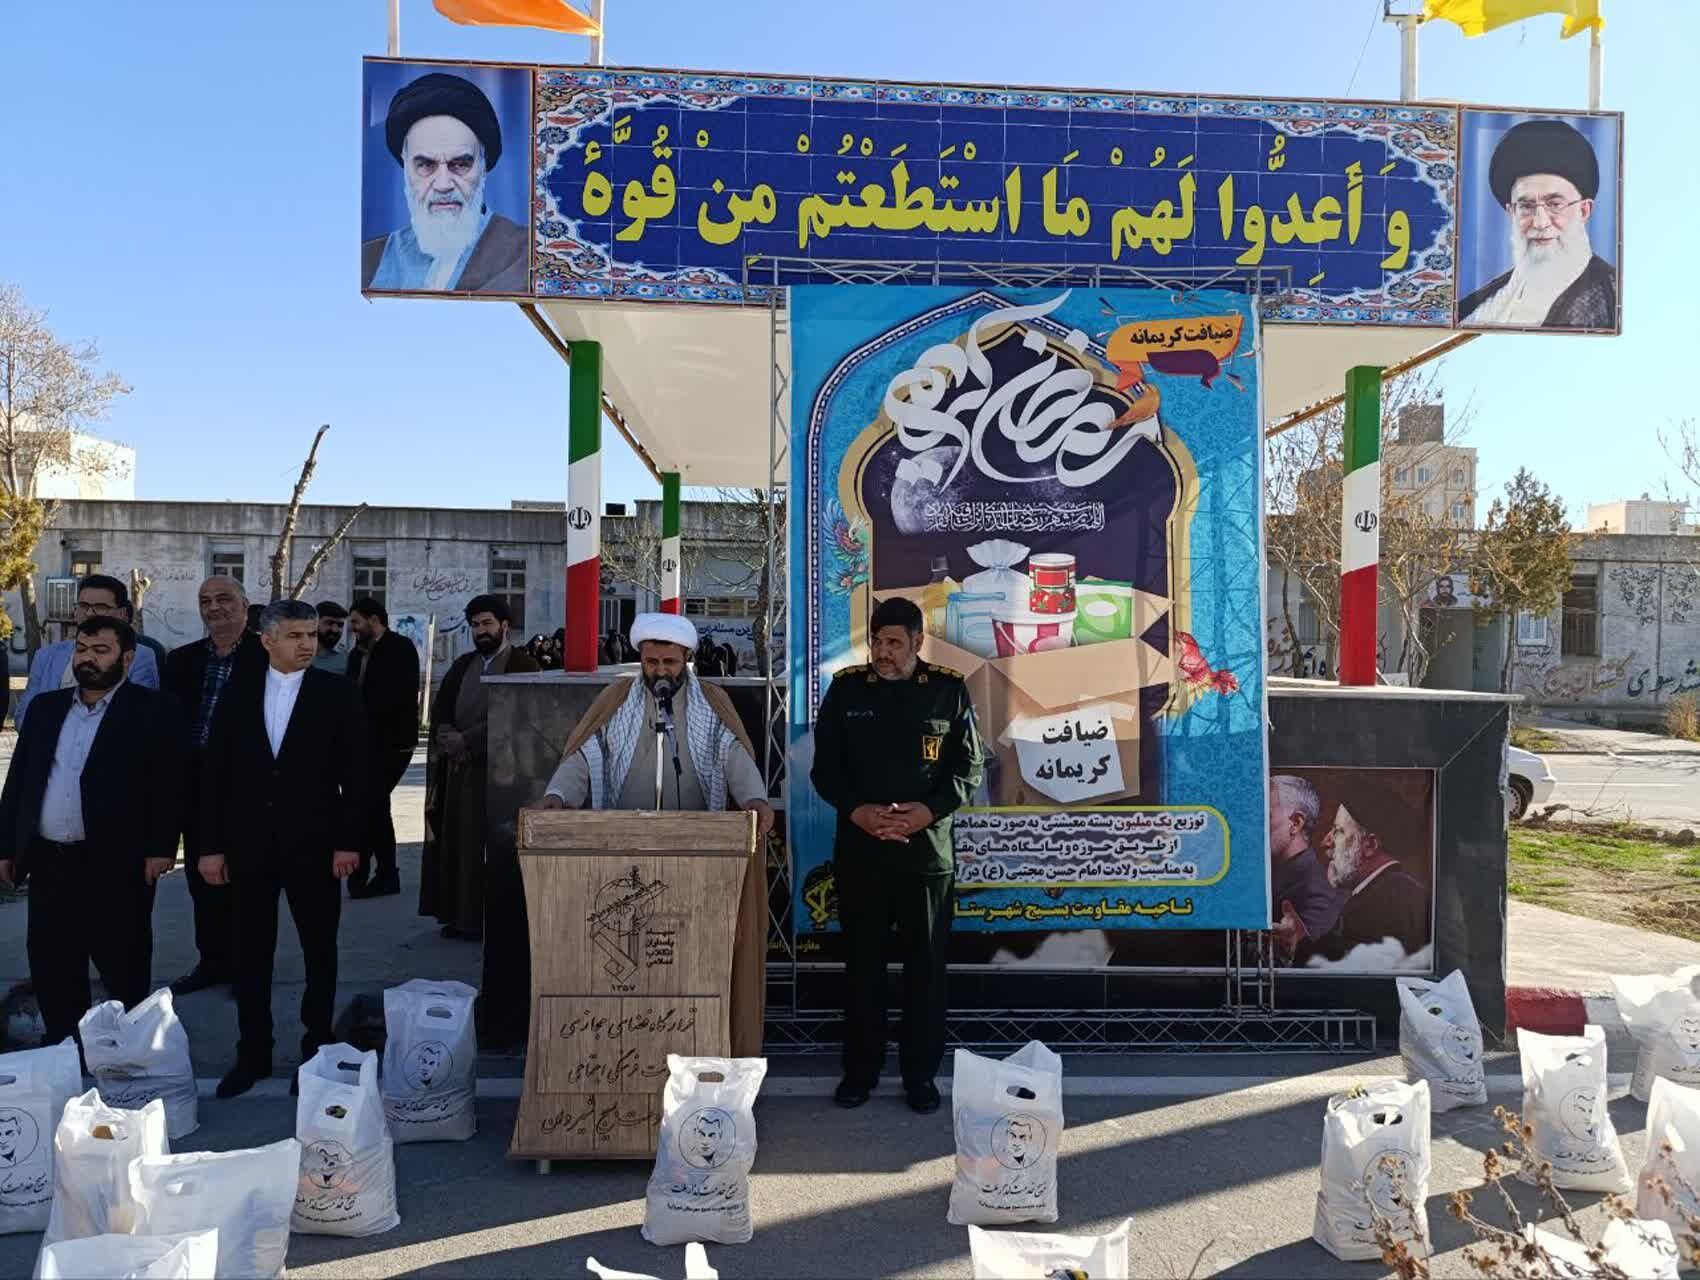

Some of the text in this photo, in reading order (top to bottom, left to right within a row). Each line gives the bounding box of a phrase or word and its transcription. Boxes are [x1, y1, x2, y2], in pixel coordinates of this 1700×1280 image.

[1130, 322, 1234, 348] ضیافت کریمانه
[884, 288, 1163, 496] رمضان کریم
[1042, 720, 1109, 746] ضیافت
[1036, 754, 1111, 784] کریمانه
[989, 818, 1026, 831] صورت
[1026, 818, 1039, 831] به
[1041, 816, 1086, 832] معیشتی
[1087, 817, 1113, 831] بسته
[1114, 816, 1152, 831] میلیون
[1153, 815, 1172, 830] یک
[1173, 814, 1205, 830] توزیع
[975, 840, 1009, 856] های
[1073, 840, 1113, 856] حوزه
[1114, 839, 1166, 855] طریق
[1167, 839, 1178, 855] از
[1006, 866, 1045, 880] مجتبی
[1046, 866, 1077, 880] حسن
[1079, 864, 1102, 880] امام
[1103, 863, 1138, 879] ولادت
[1140, 862, 1181, 879] مناسبت
[1182, 864, 1194, 878] به
[953, 896, 1194, 922] ناحیه مقاومت بسیج شهرستا
[650, 1007, 697, 1033] قرارگاه
